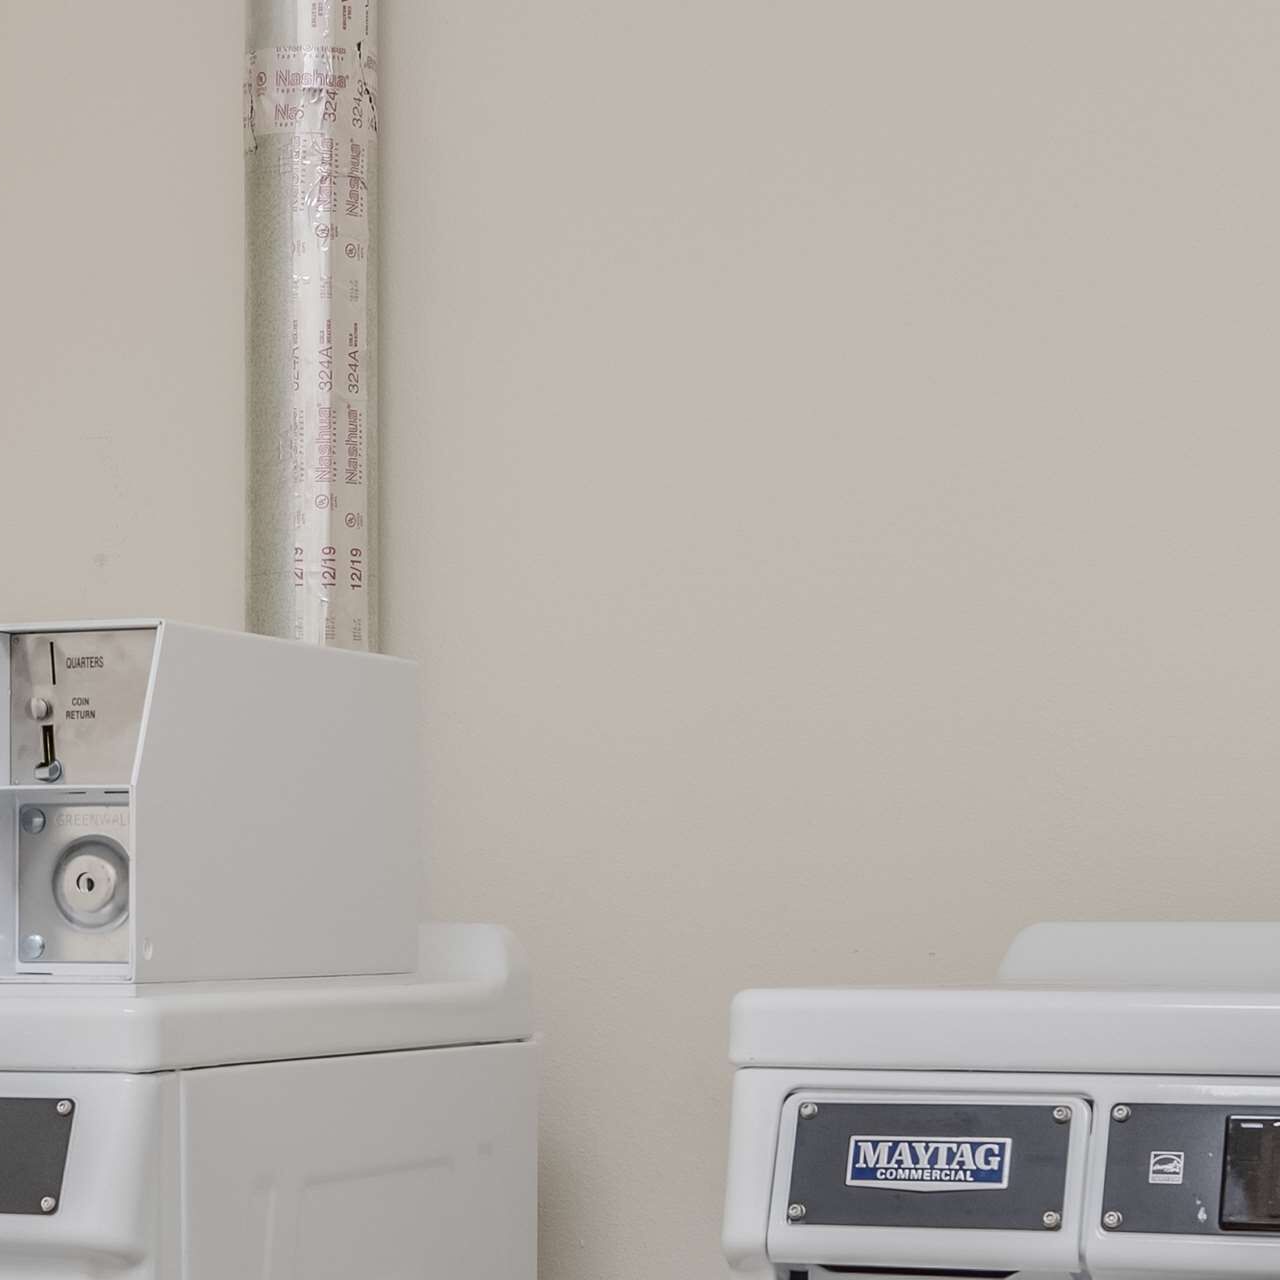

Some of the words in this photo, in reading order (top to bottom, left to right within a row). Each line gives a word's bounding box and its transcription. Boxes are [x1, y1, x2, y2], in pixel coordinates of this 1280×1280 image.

[318, 346, 333, 391] 324A
[348, 350, 359, 394] 324A
[314, 407, 332, 483] Nashua
[344, 408, 358, 485] Nashua
[321, 546, 336, 589] 12/19
[350, 547, 362, 590] 12/19
[65, 656, 104, 669] QUARTERS
[65, 710, 96, 720] RETURN
[71, 697, 90, 707] COIN
[56, 814, 129, 826] GREENWAL
[855, 1141, 1001, 1171] MAYTAG
[876, 1168, 974, 1182] COMMERCIAL
